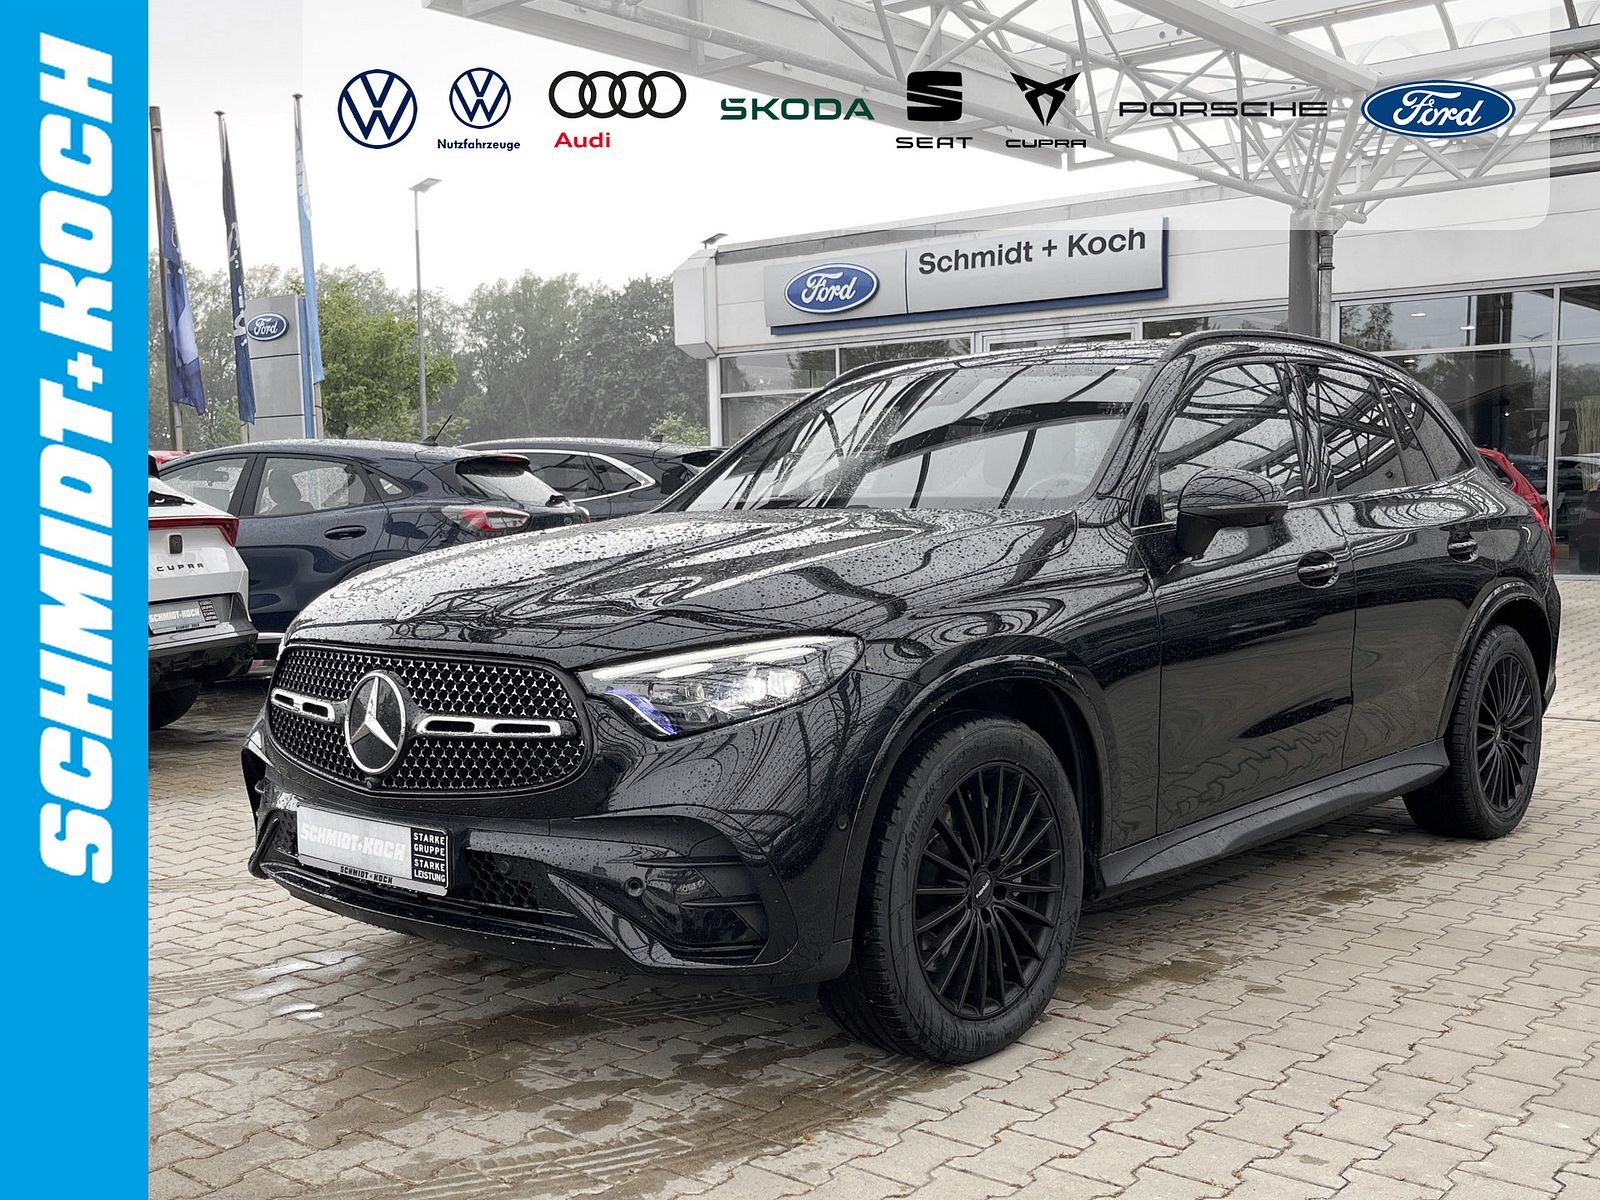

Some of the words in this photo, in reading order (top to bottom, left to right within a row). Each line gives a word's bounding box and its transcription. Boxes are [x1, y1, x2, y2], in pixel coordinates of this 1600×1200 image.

[919, 241, 1033, 275] Schmidt
[1068, 229, 1146, 258] Koch
[801, 272, 858, 304] Ford
[253, 317, 278, 336] Ford
[156, 562, 205, 572] CUPRA
[413, 832, 446, 846] STARKE
[413, 843, 446, 857] GRUPPE
[413, 858, 446, 872] STARKE
[413, 869, 446, 883] LEISTUNG
